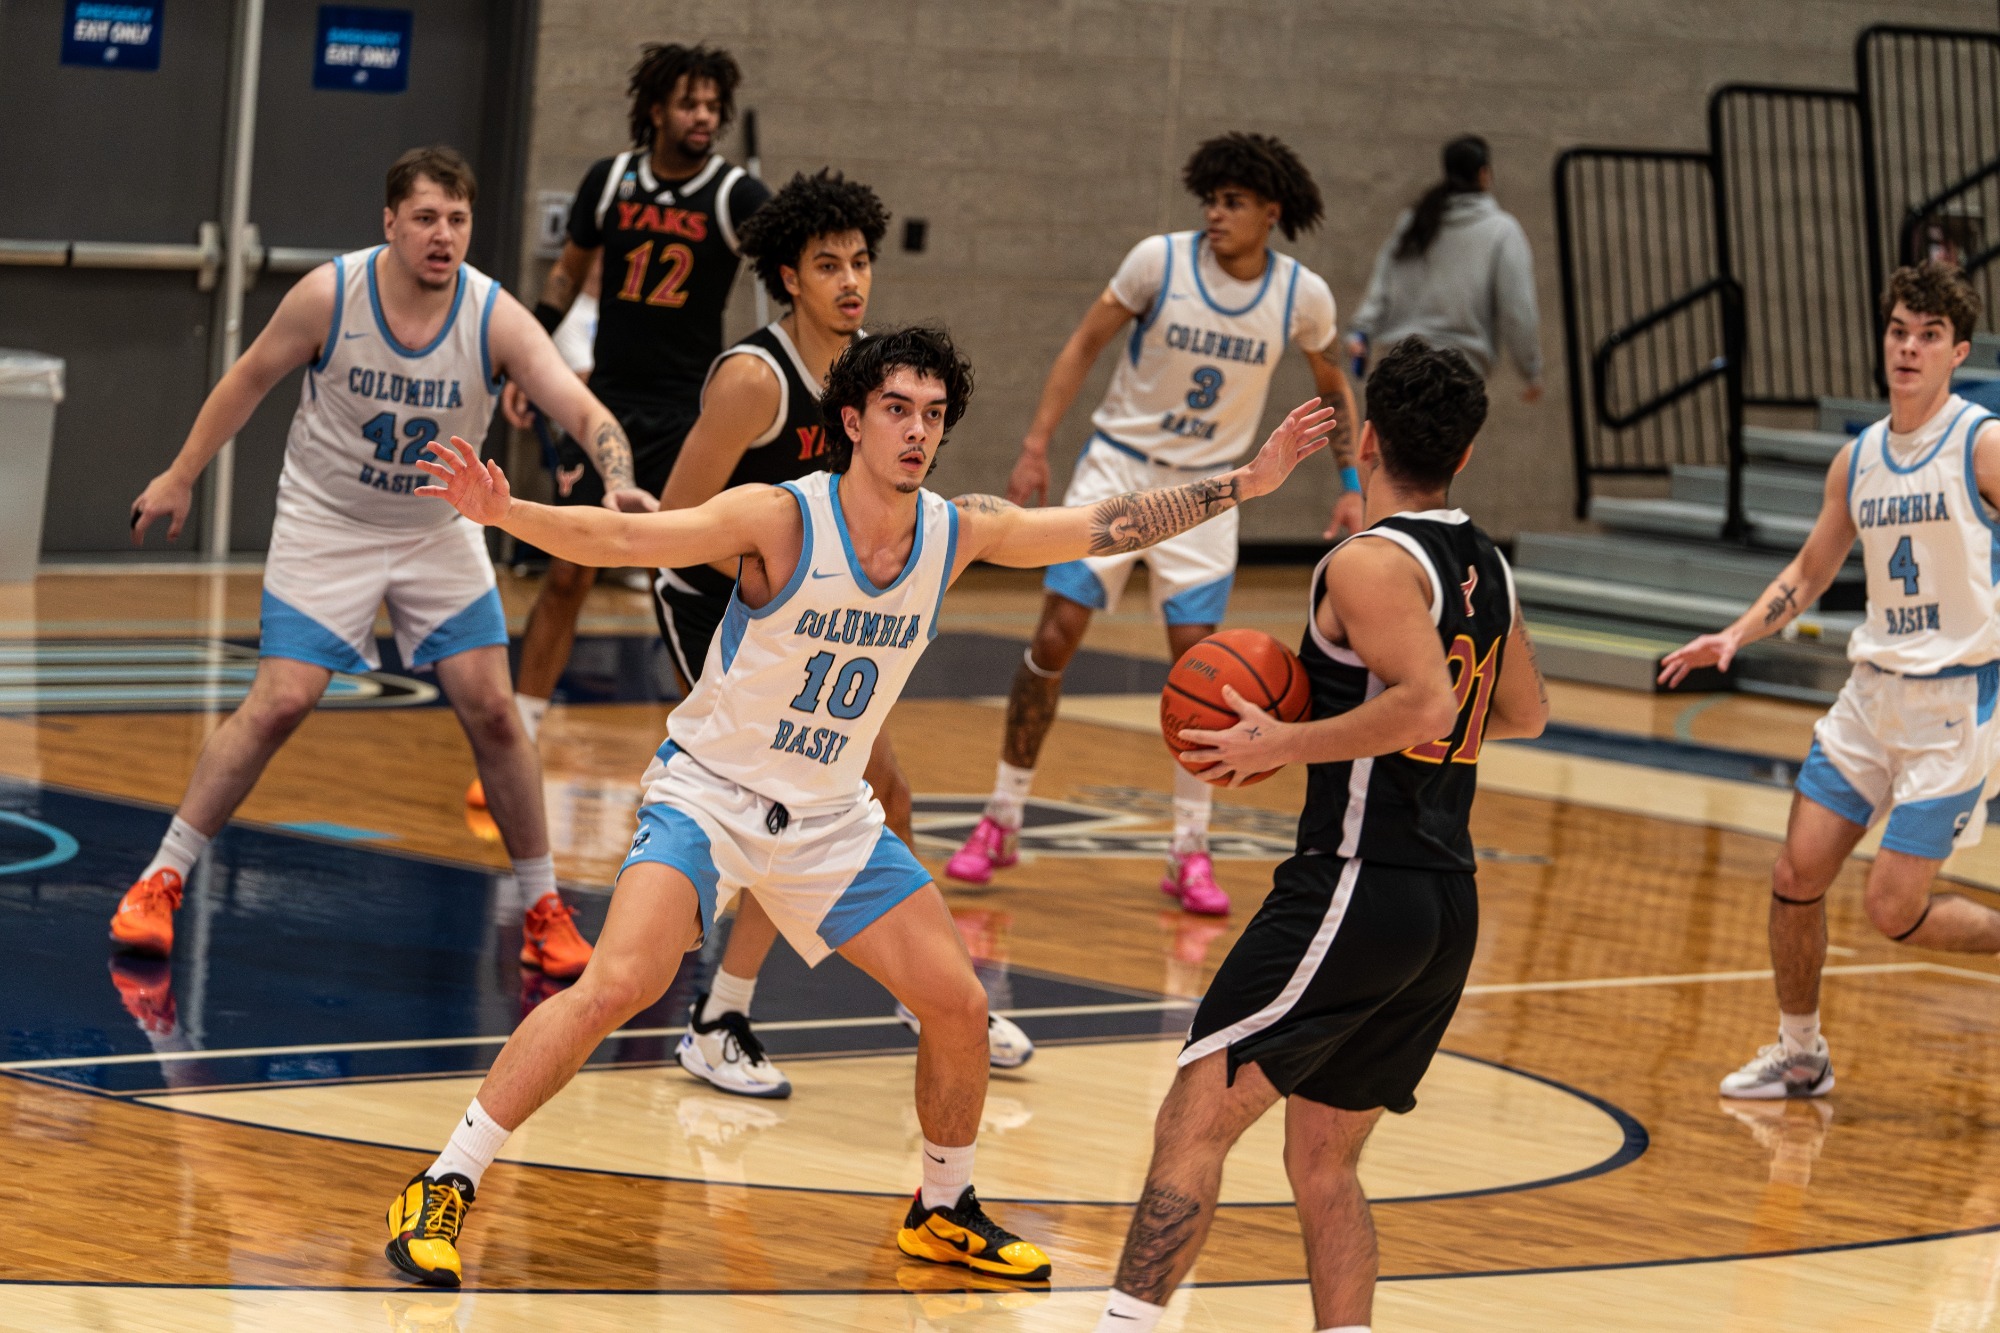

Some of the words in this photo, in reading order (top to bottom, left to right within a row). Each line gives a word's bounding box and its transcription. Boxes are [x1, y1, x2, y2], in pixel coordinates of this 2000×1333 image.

[73, 19, 110, 42] EXIT
[109, 22, 152, 45] ONLY
[324, 43, 360, 66] EXIT
[360, 45, 400, 69] ONLY
[617, 201, 708, 242] YAKS
[617, 240, 694, 308] 12
[1166, 323, 1267, 364] COLUMBIA
[348, 366, 462, 408] COLUMBIA
[1186, 366, 1224, 411] 3
[362, 411, 439, 464] 42
[1859, 492, 1950, 529] COLUMBIA
[1888, 535, 1919, 596] 4
[794, 608, 921, 649] COLUMBIA
[789, 650, 879, 720] 10
[1401, 634, 1502, 765] 21
